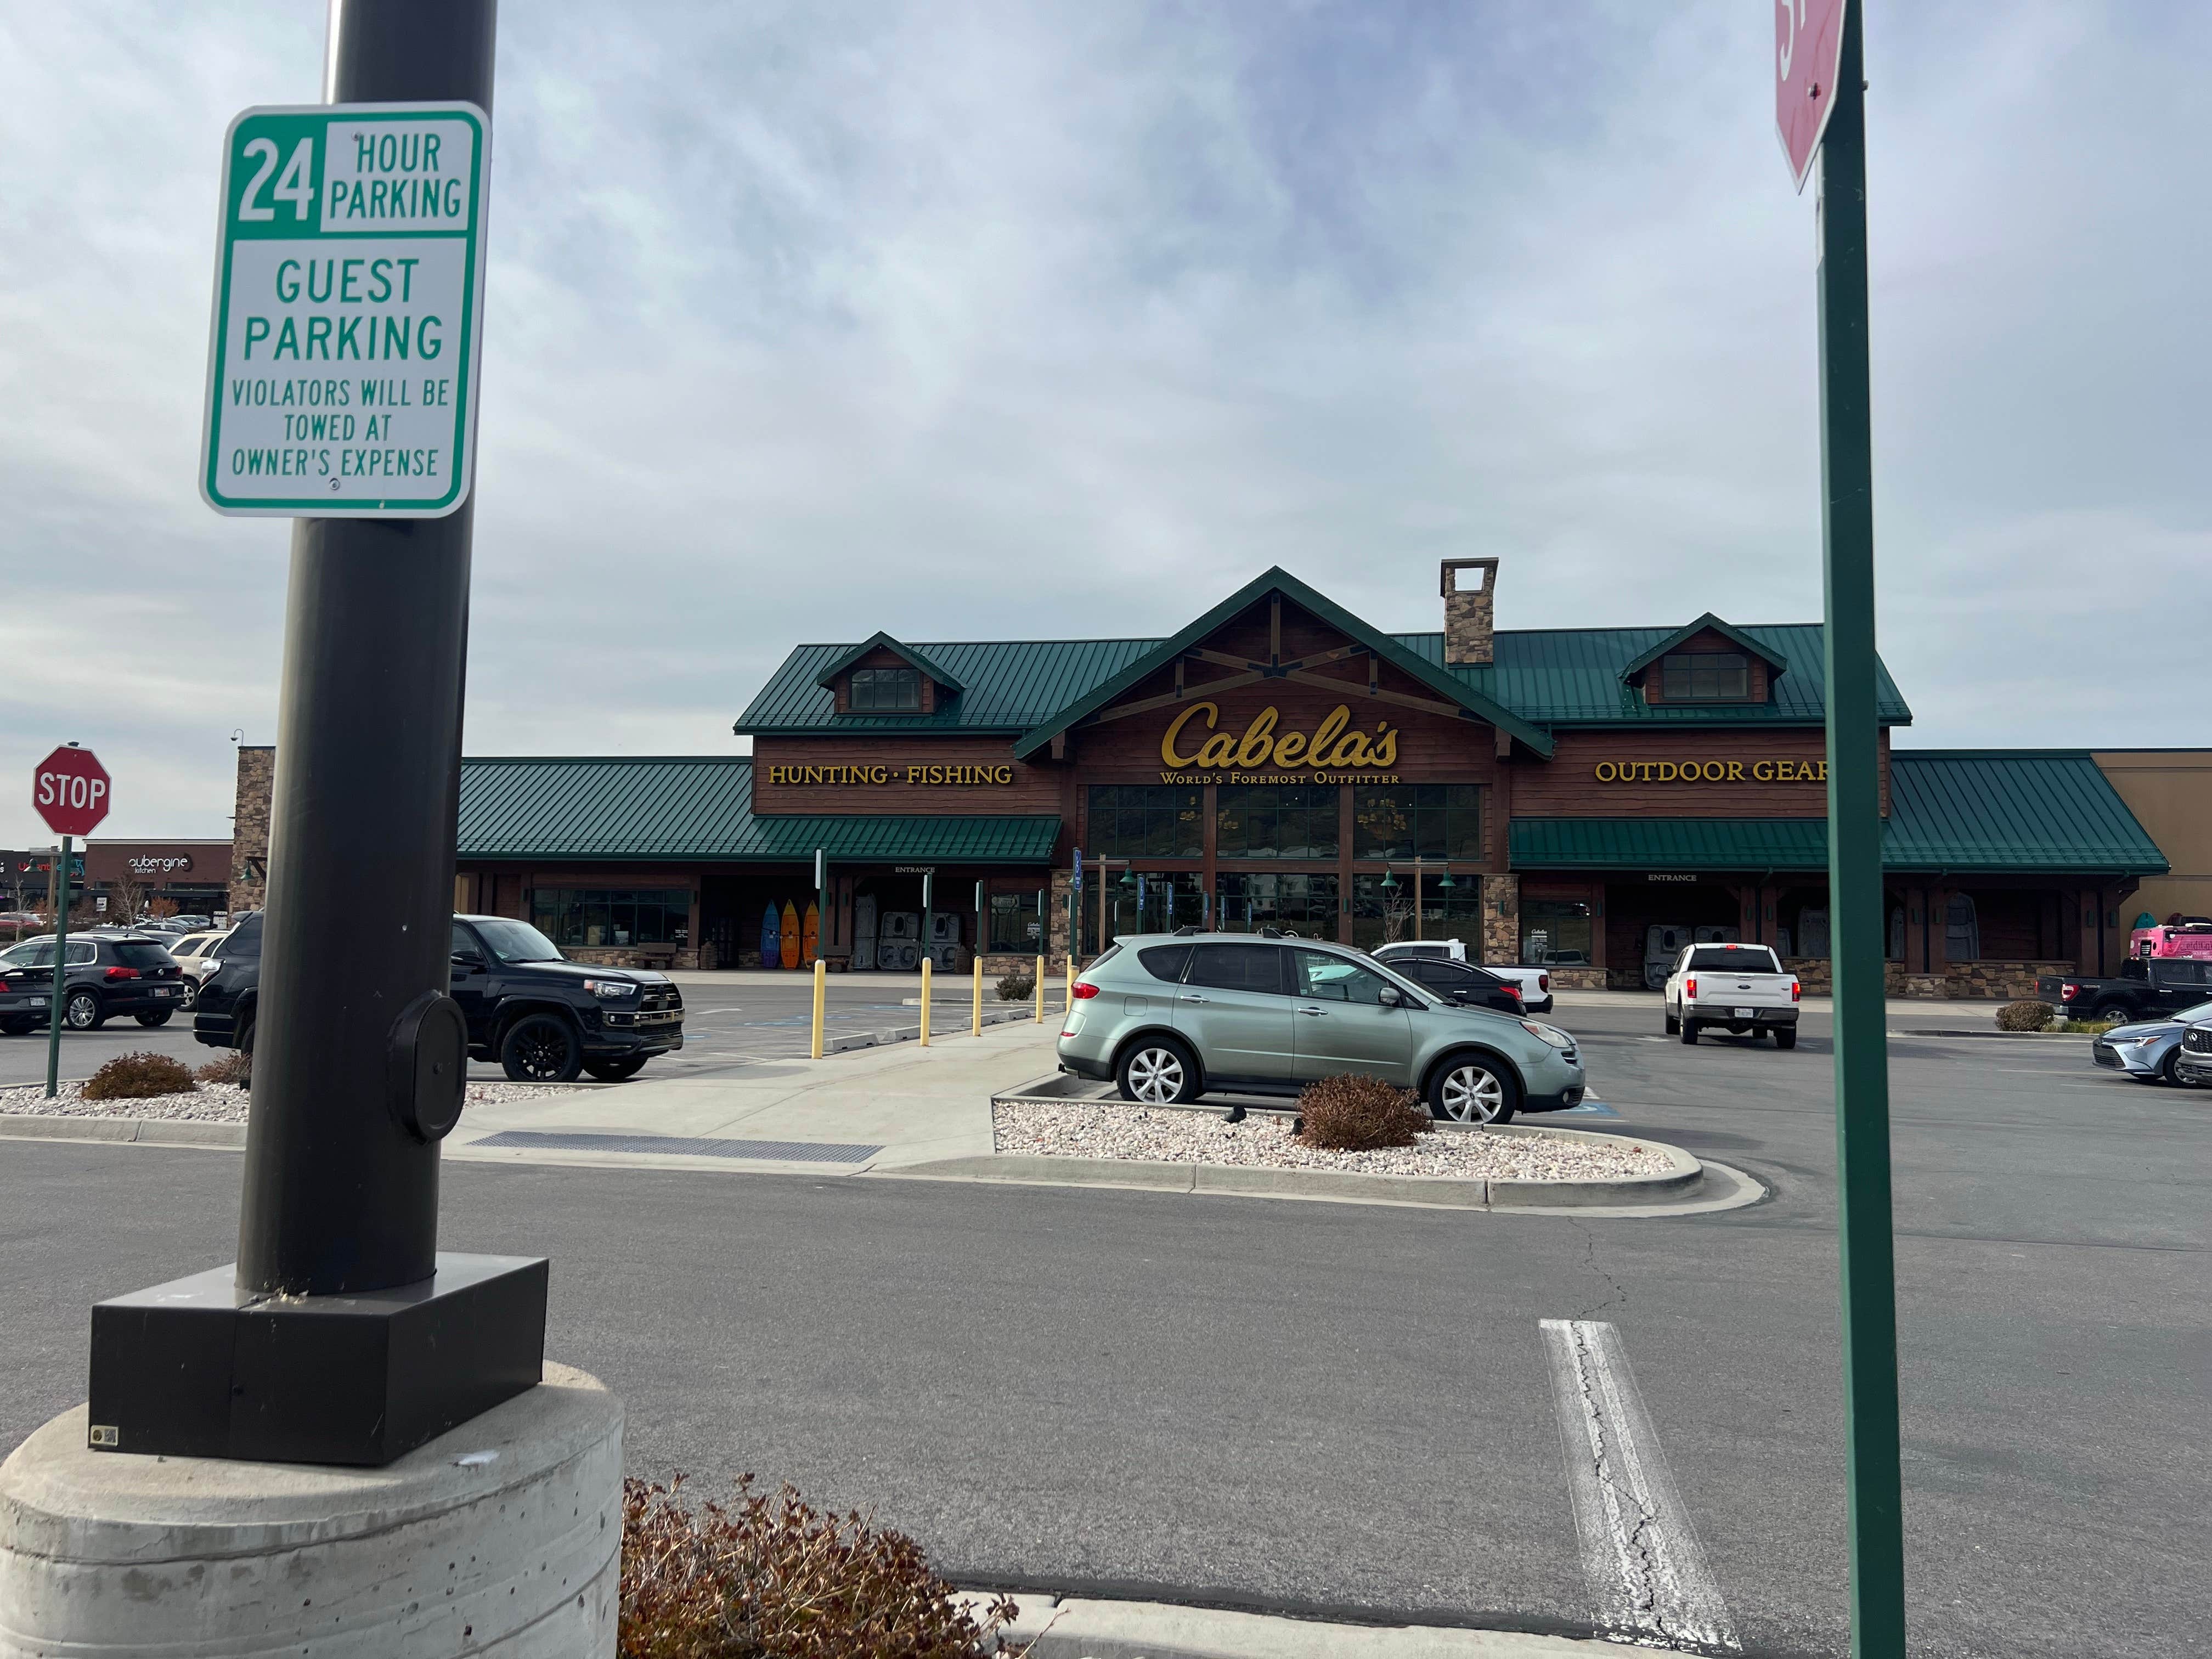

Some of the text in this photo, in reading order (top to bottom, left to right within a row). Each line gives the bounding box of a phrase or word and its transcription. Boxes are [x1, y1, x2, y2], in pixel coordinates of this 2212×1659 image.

[356, 133, 441, 173] HOUR
[238, 137, 314, 221] 24
[329, 178, 461, 219] PARKING
[276, 258, 420, 303] GUEST
[244, 315, 443, 360] PARKING
[232, 379, 450, 407] VIOLATORS WILL BE
[284, 414, 392, 442] TOWED AT
[232, 448, 439, 477] OWNER'S EXPENSE
[1161, 701, 1399, 769] Cabela's
[769, 766, 887, 784] HUNTING
[906, 765, 1013, 784] FISHING
[1595, 760, 1746, 782] OUTDOOR
[38, 772, 106, 809] STOP
[128, 854, 188, 872] aubergine
